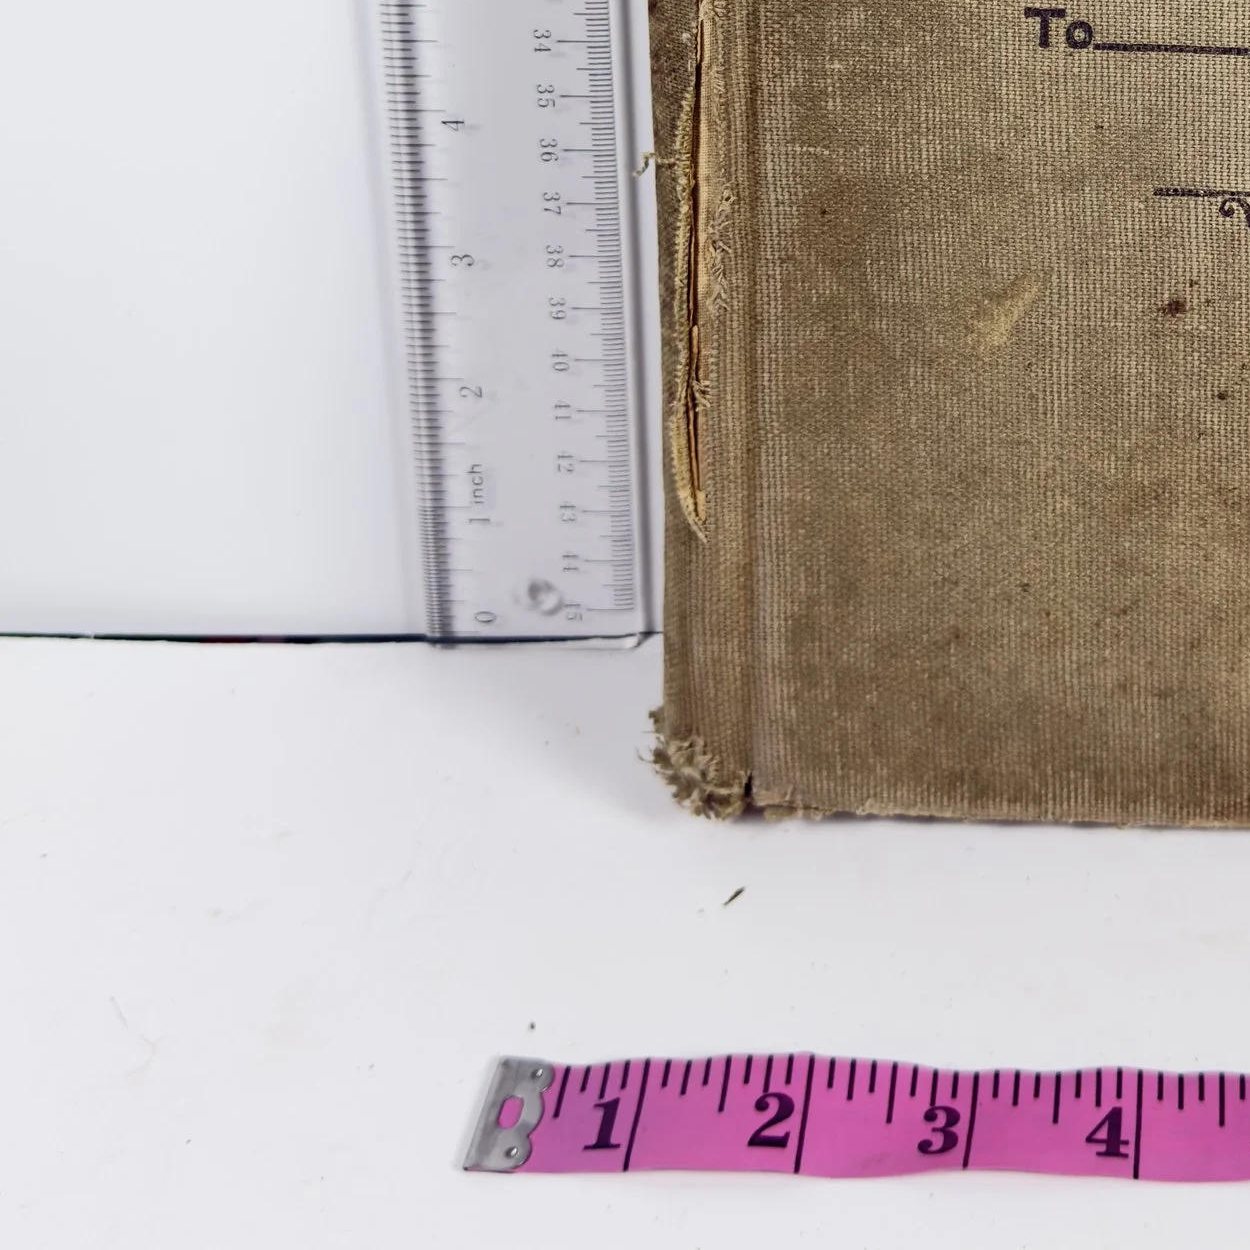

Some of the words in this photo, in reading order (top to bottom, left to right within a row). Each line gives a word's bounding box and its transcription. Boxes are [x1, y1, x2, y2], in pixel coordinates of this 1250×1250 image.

[1024, 7, 1093, 49] To
[533, 29, 552, 53] 34
[536, 84, 556, 108] 35
[441, 120, 465, 131] 4
[539, 138, 559, 162] 36
[543, 192, 561, 215] 37
[450, 254, 475, 267] 3
[545, 245, 564, 268] 38
[548, 297, 567, 320] 39
[459, 386, 483, 398] 2
[467, 463, 484, 504] inch
[582, 1098, 622, 1150] 1
[747, 1093, 795, 1148] 2
[917, 1105, 960, 1155] 3
[1084, 1106, 1130, 1159] 4
